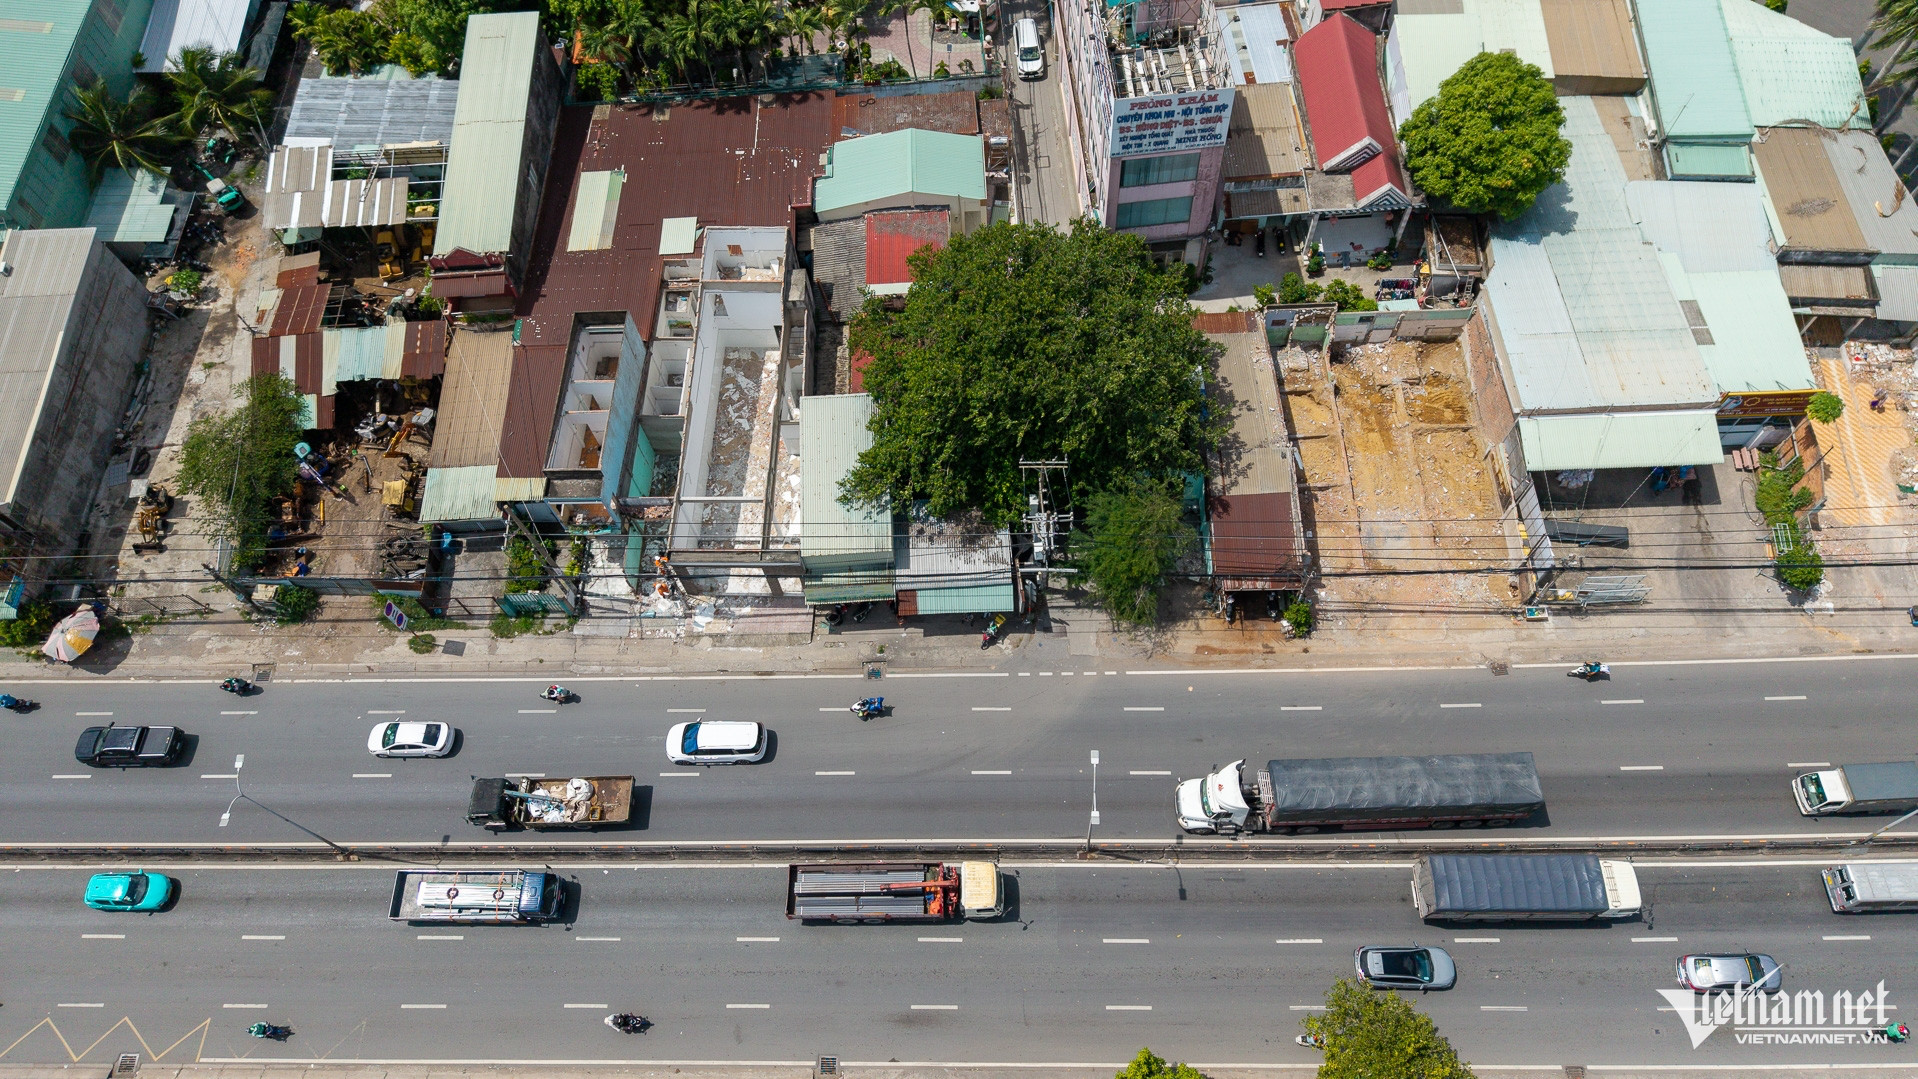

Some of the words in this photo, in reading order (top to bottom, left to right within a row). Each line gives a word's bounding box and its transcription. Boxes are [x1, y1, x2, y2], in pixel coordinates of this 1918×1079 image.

[1130, 98, 1172, 110] PHÒNG
[1177, 93, 1219, 105] KHÁM
[1117, 112, 1143, 123] CHUYÊN
[1144, 111, 1162, 120] KHOA
[1181, 107, 1193, 117] NỘI
[1195, 103, 1213, 115] TỔNG
[1175, 136, 1198, 144] MINH
